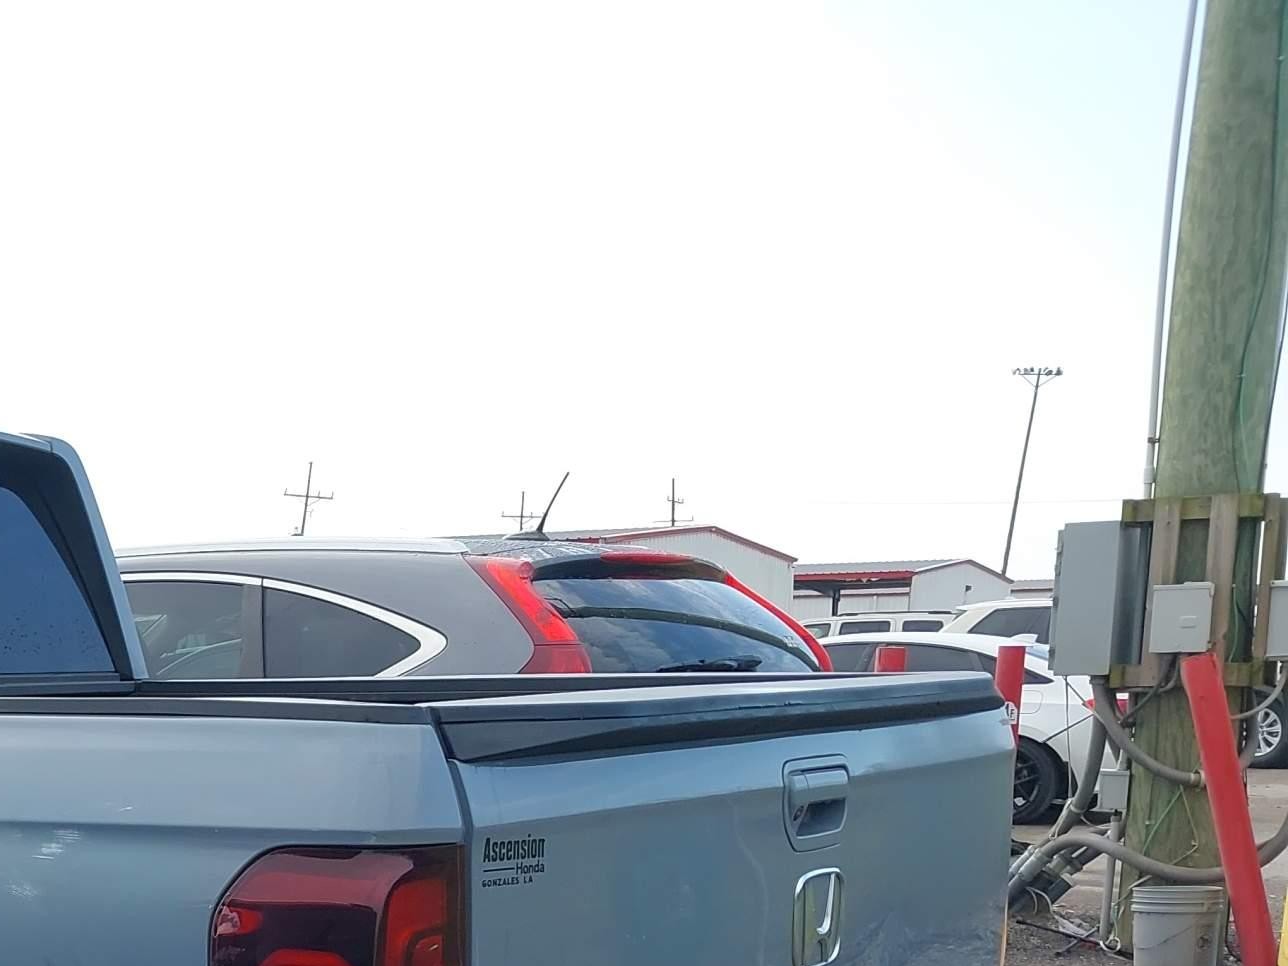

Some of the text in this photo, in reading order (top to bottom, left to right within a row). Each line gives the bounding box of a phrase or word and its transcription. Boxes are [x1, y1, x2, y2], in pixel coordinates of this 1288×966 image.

[483, 833, 546, 863] Ascension
[515, 860, 545, 875] Honda
[482, 875, 534, 888] GONZALES LA
